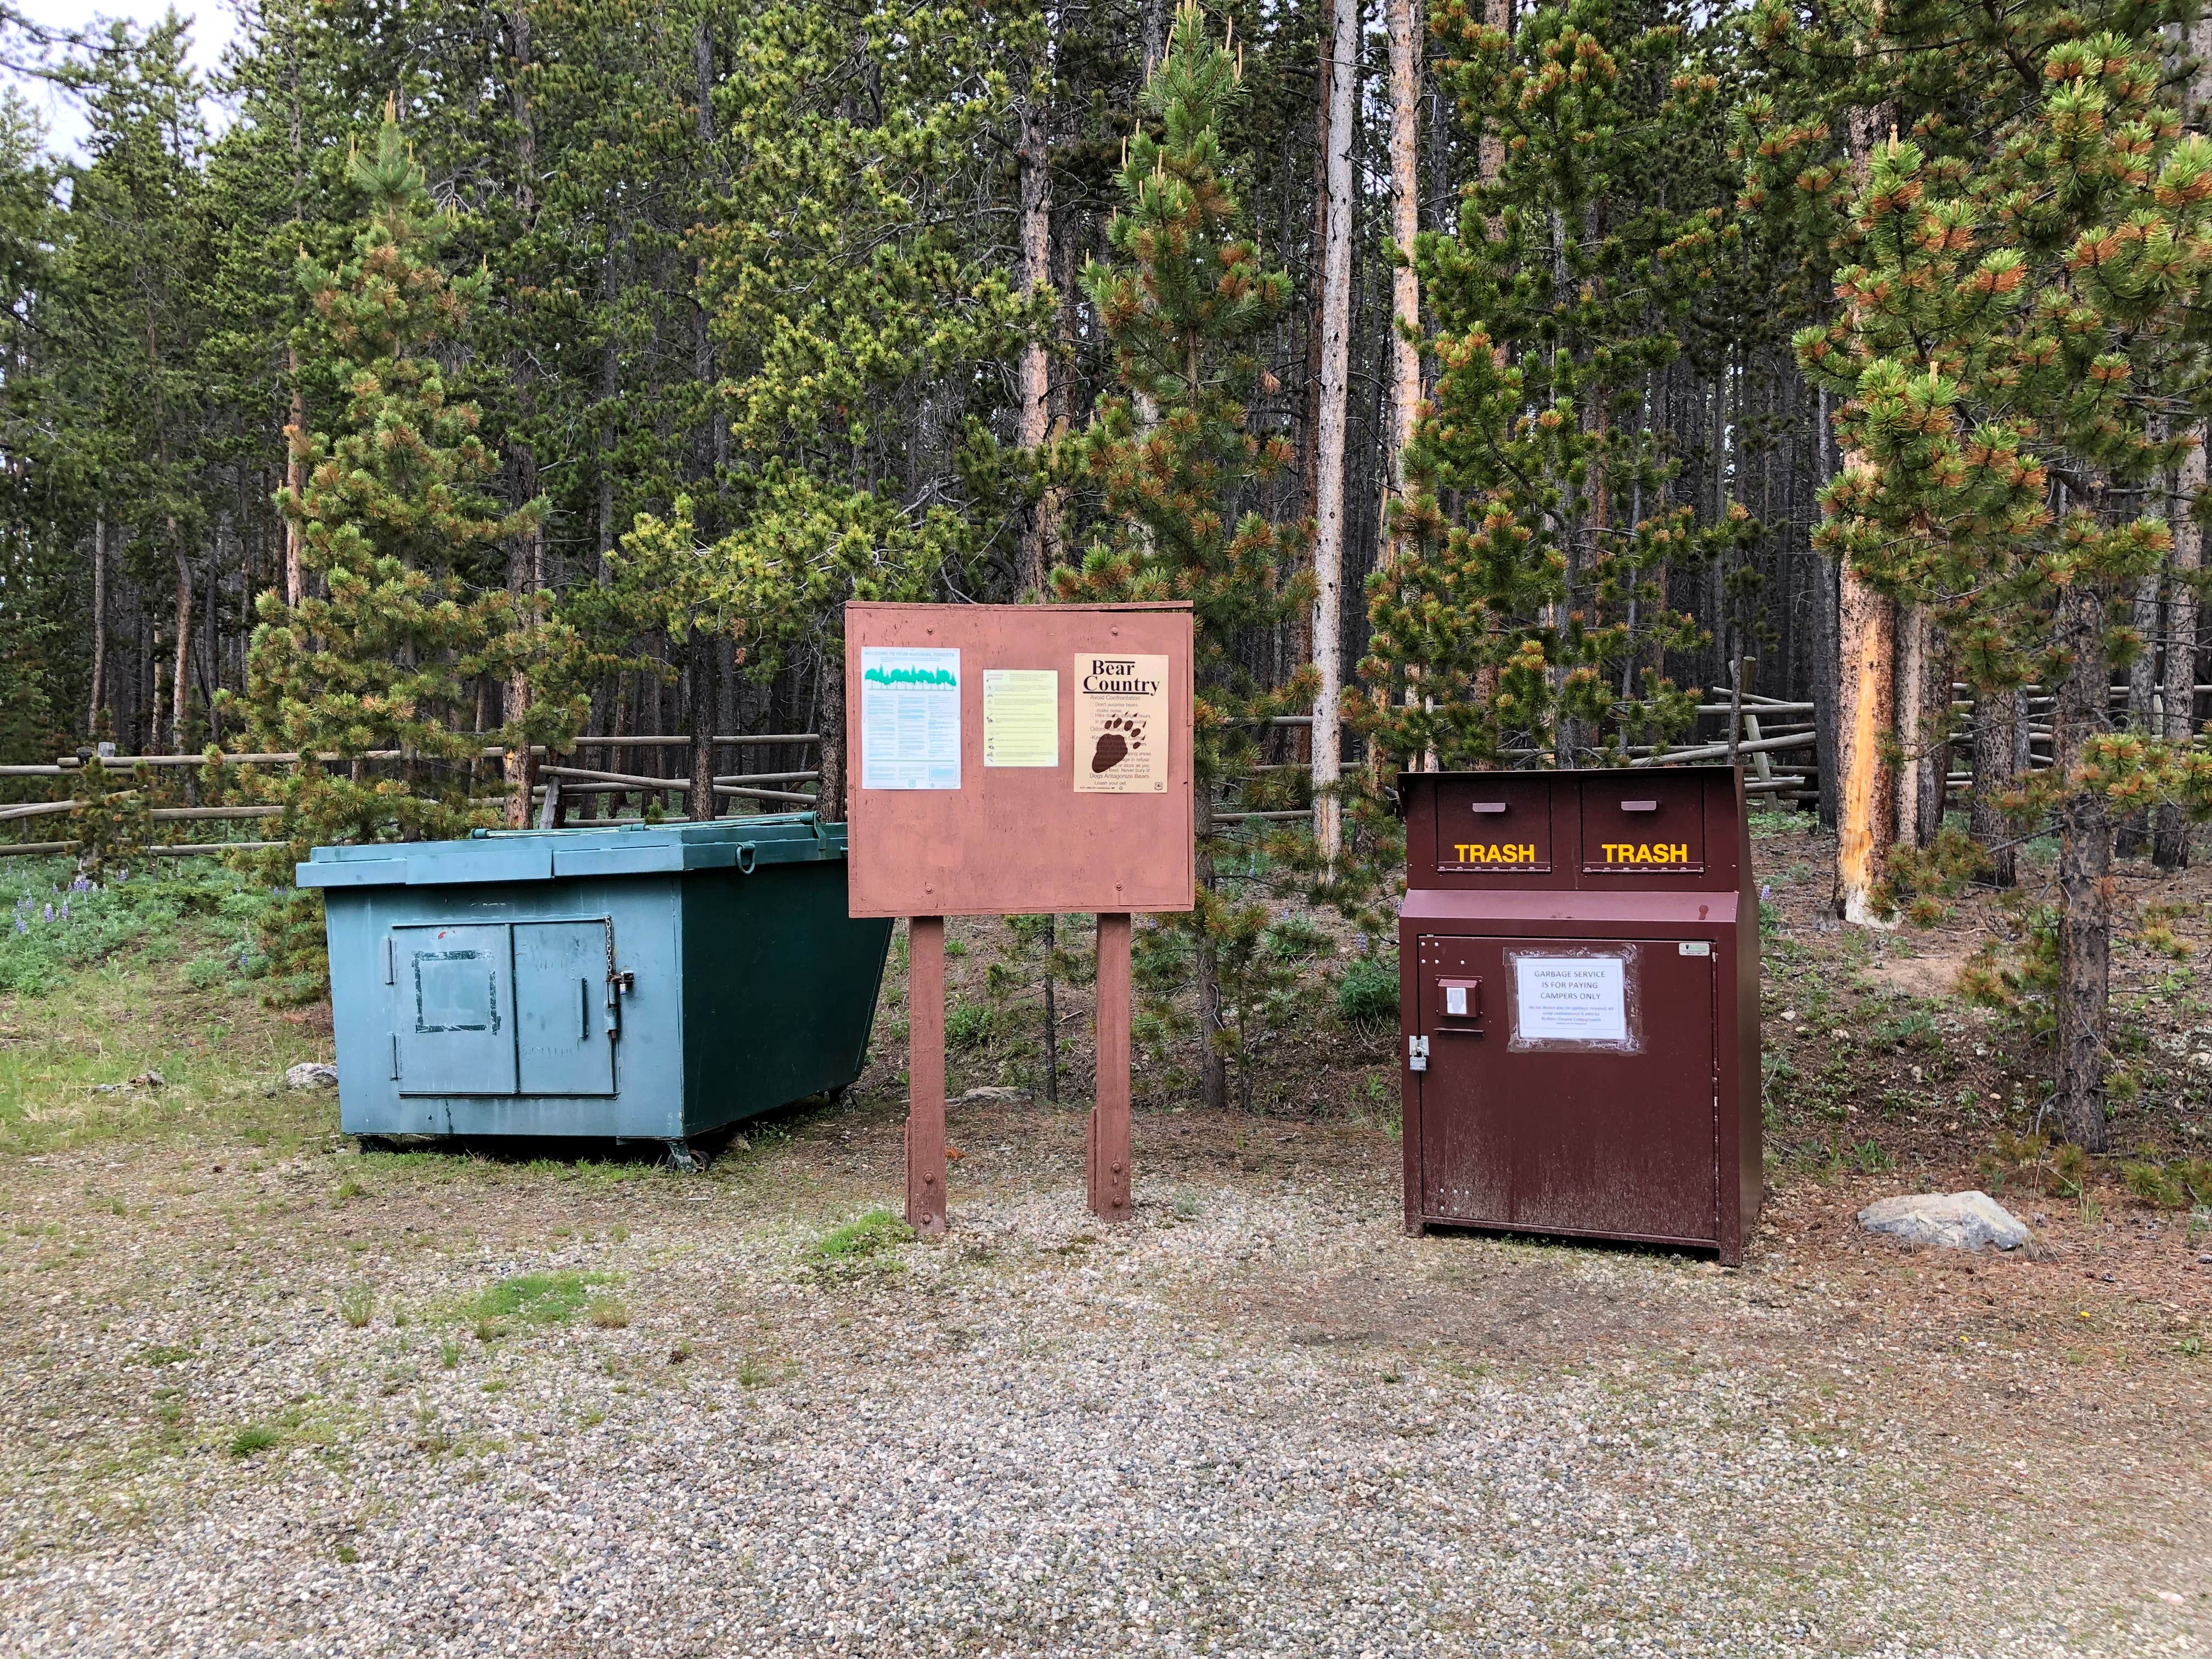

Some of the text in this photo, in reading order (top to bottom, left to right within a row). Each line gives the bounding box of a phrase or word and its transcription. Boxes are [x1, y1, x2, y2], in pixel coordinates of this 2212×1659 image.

[1092, 660, 1135, 675] Bear
[1084, 675, 1160, 696] Country
[1454, 844, 1535, 862] TRASH
[1601, 844, 1688, 863] TRASH
